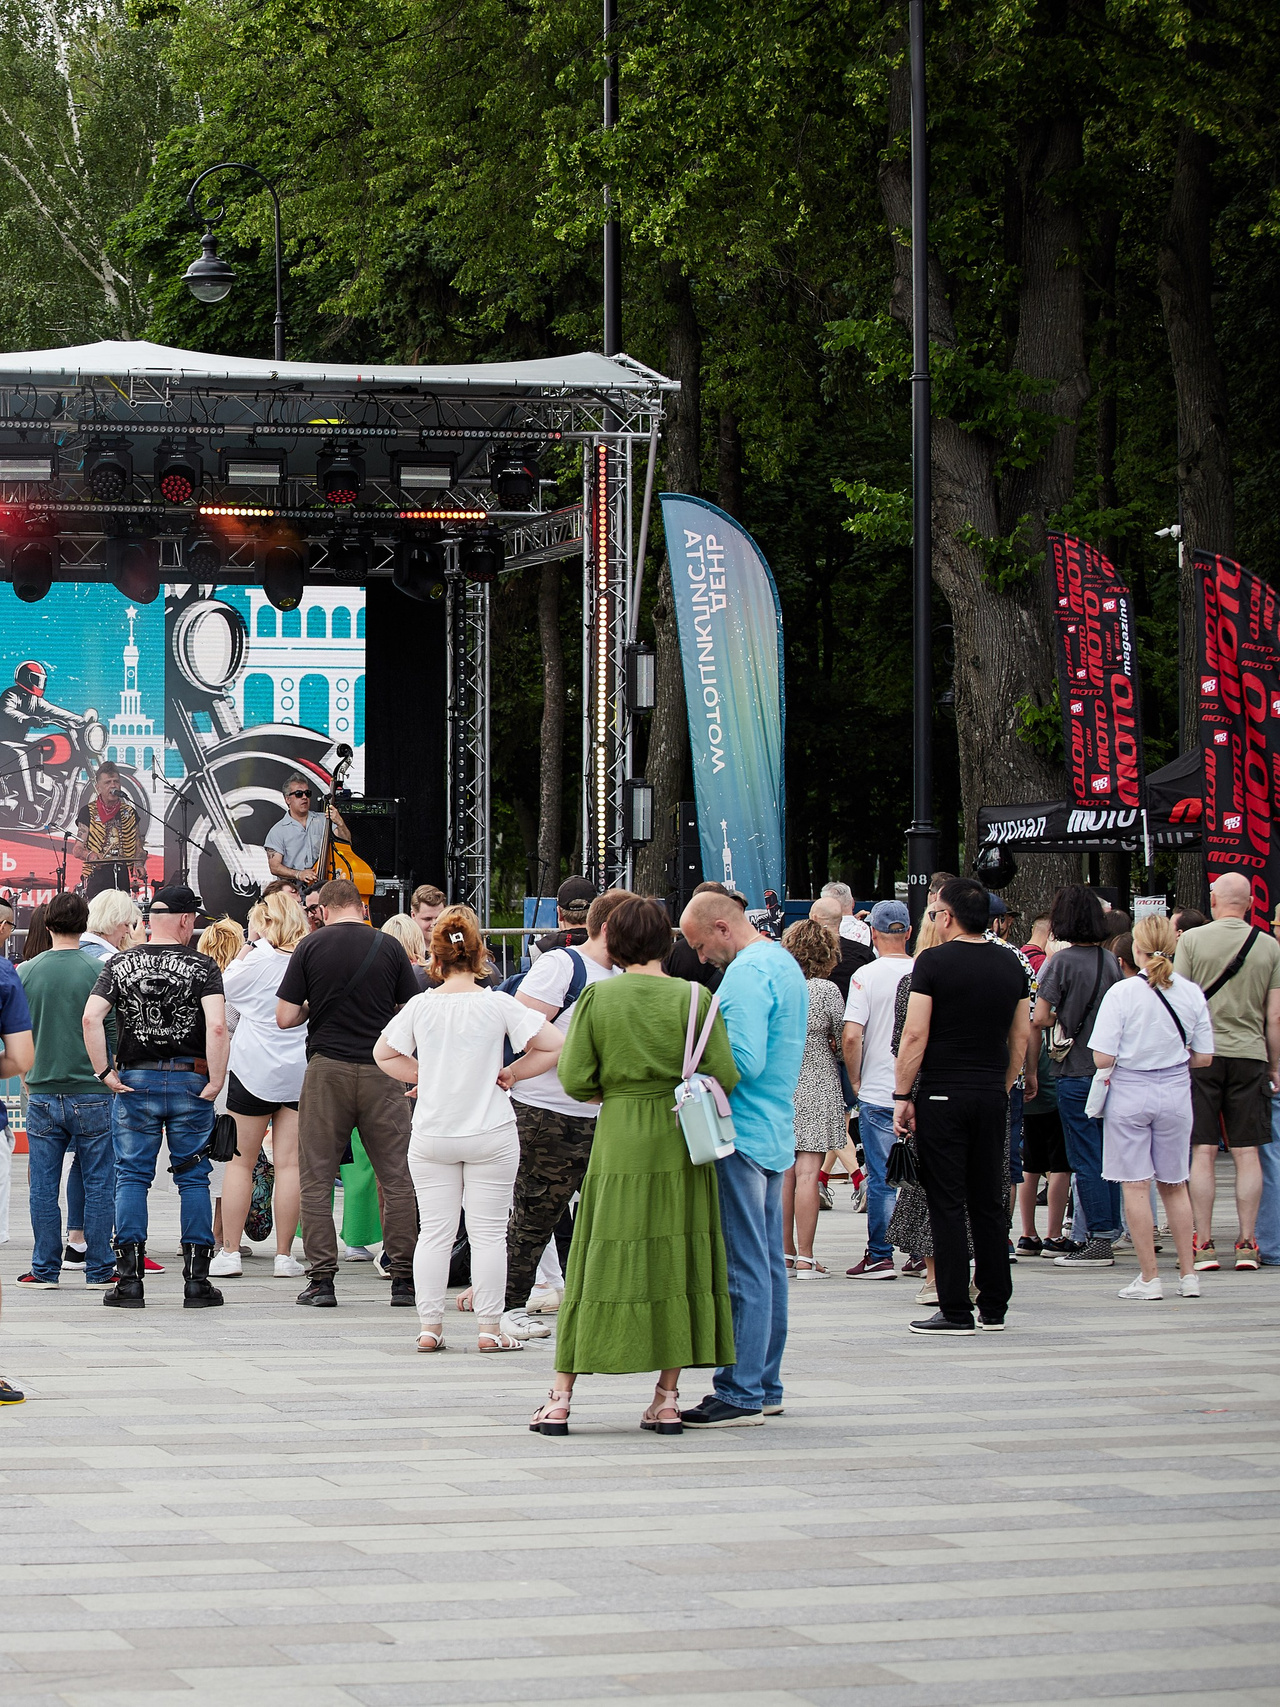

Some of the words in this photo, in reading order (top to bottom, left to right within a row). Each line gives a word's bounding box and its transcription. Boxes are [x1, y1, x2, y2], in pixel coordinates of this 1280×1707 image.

[1119, 598, 1131, 676] magazine
[1111, 673, 1139, 807] MOTO
[1242, 672, 1270, 856] MOTO
[1207, 850, 1266, 868] MOTO
